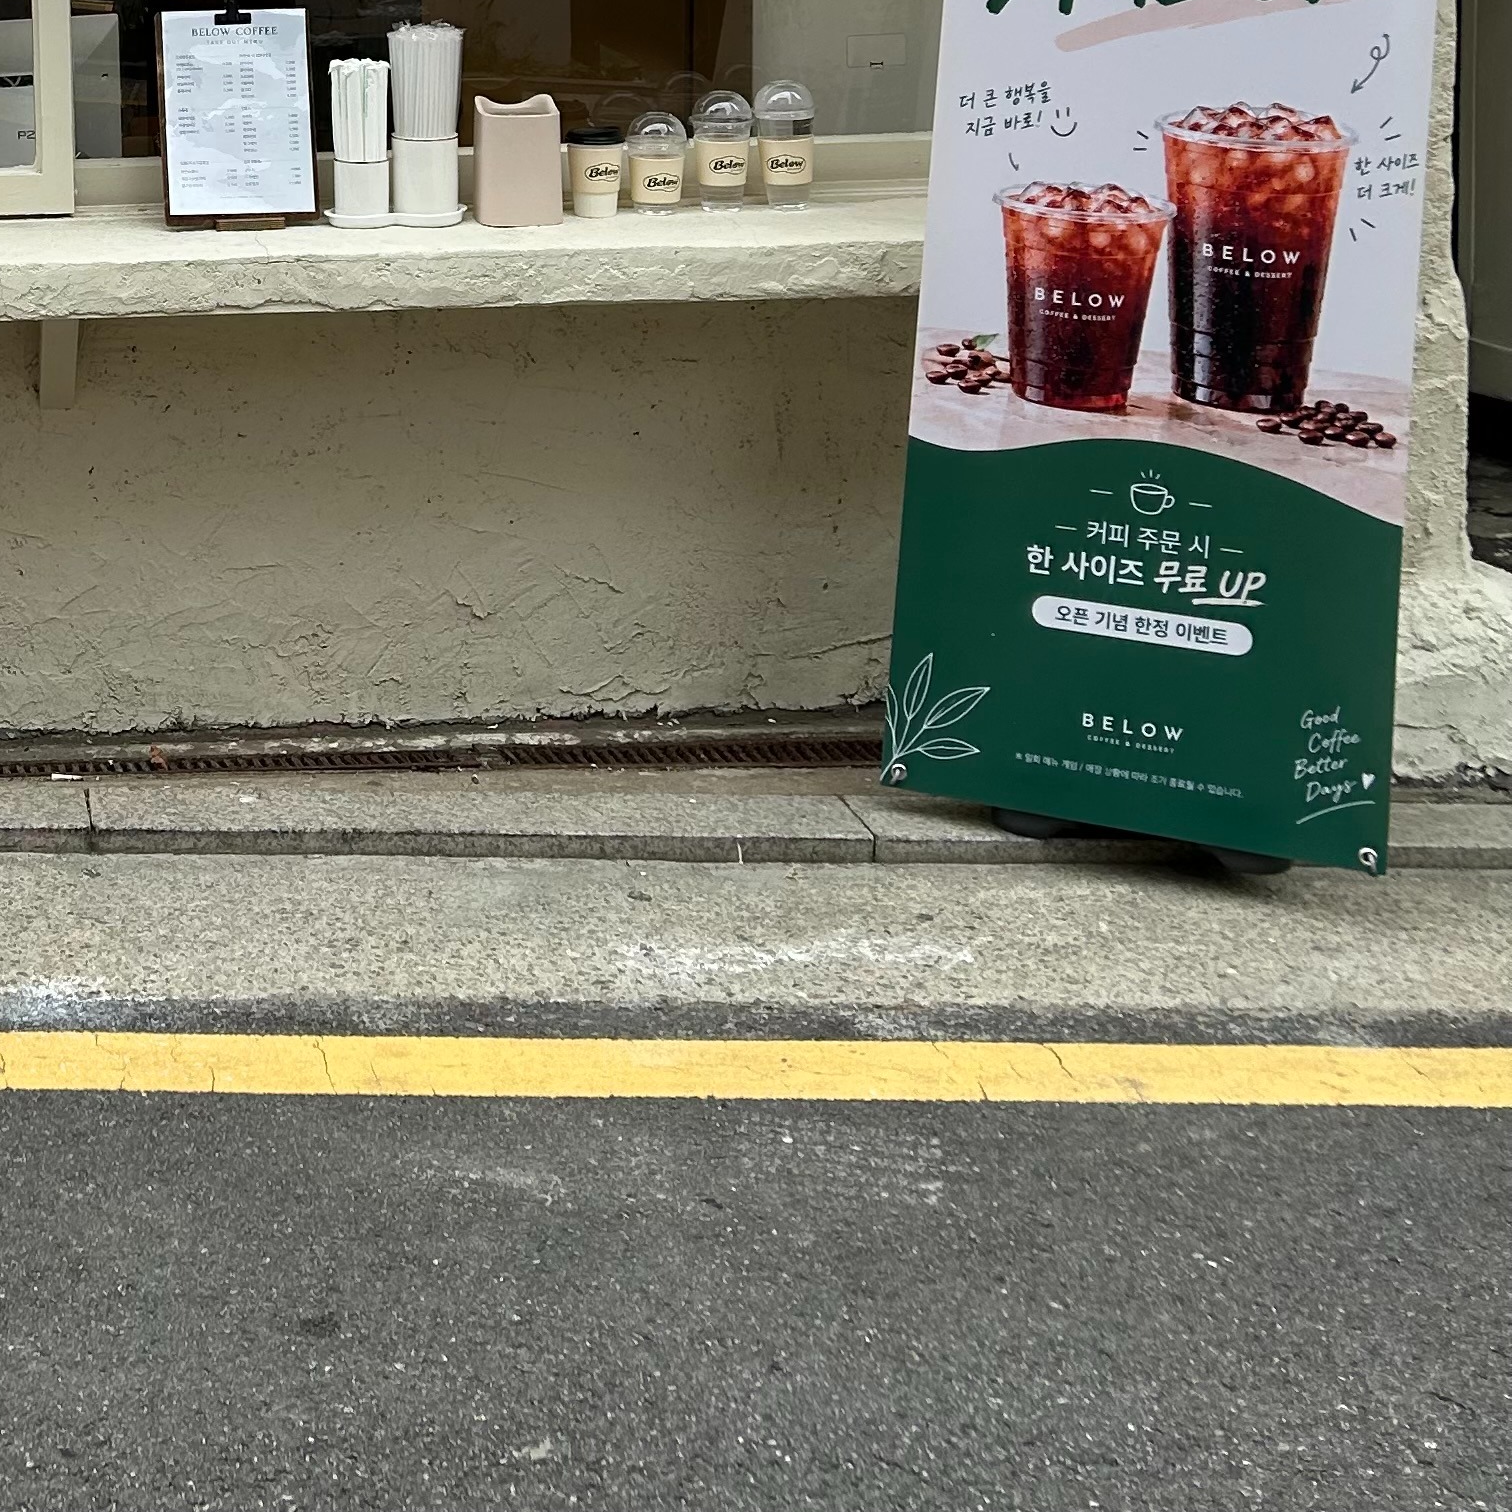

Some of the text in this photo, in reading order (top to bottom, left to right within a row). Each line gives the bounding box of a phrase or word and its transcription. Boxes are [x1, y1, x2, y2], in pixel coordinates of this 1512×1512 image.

[191, 26, 279, 37] BELOW COFFEE
[959, 80, 1052, 110] 더 큰 행복을
[965, 110, 1043, 137] 지금 바로!
[588, 166, 620, 179] Below
[713, 158, 745, 171] Below
[769, 158, 804, 170] Below
[1354, 153, 1420, 176] 한 사이즈
[646, 176, 679, 189] Below
[1357, 177, 1416, 200] 더 크게!
[1202, 243, 1300, 265] BELOW
[1208, 265, 1240, 276] COFFEE
[1254, 271, 1293, 279] DESSERT
[1034, 287, 1125, 308] BELOW
[1039, 308, 1069, 319] COFFEE
[1082, 314, 1117, 322] DESSERT
[1087, 520, 1211, 559] 커피 주문 시
[1026, 544, 1267, 601] 한 사이즈 무료 UP
[1054, 604, 1229, 646] 오픈 기념 한정 이벤트
[1082, 712, 1184, 741] BELOW
[1300, 705, 1341, 729] Good
[1087, 734, 1120, 746] COFFEE
[1308, 728, 1362, 753] Coffee
[1294, 756, 1348, 779] Better
[1306, 780, 1357, 803] Days
